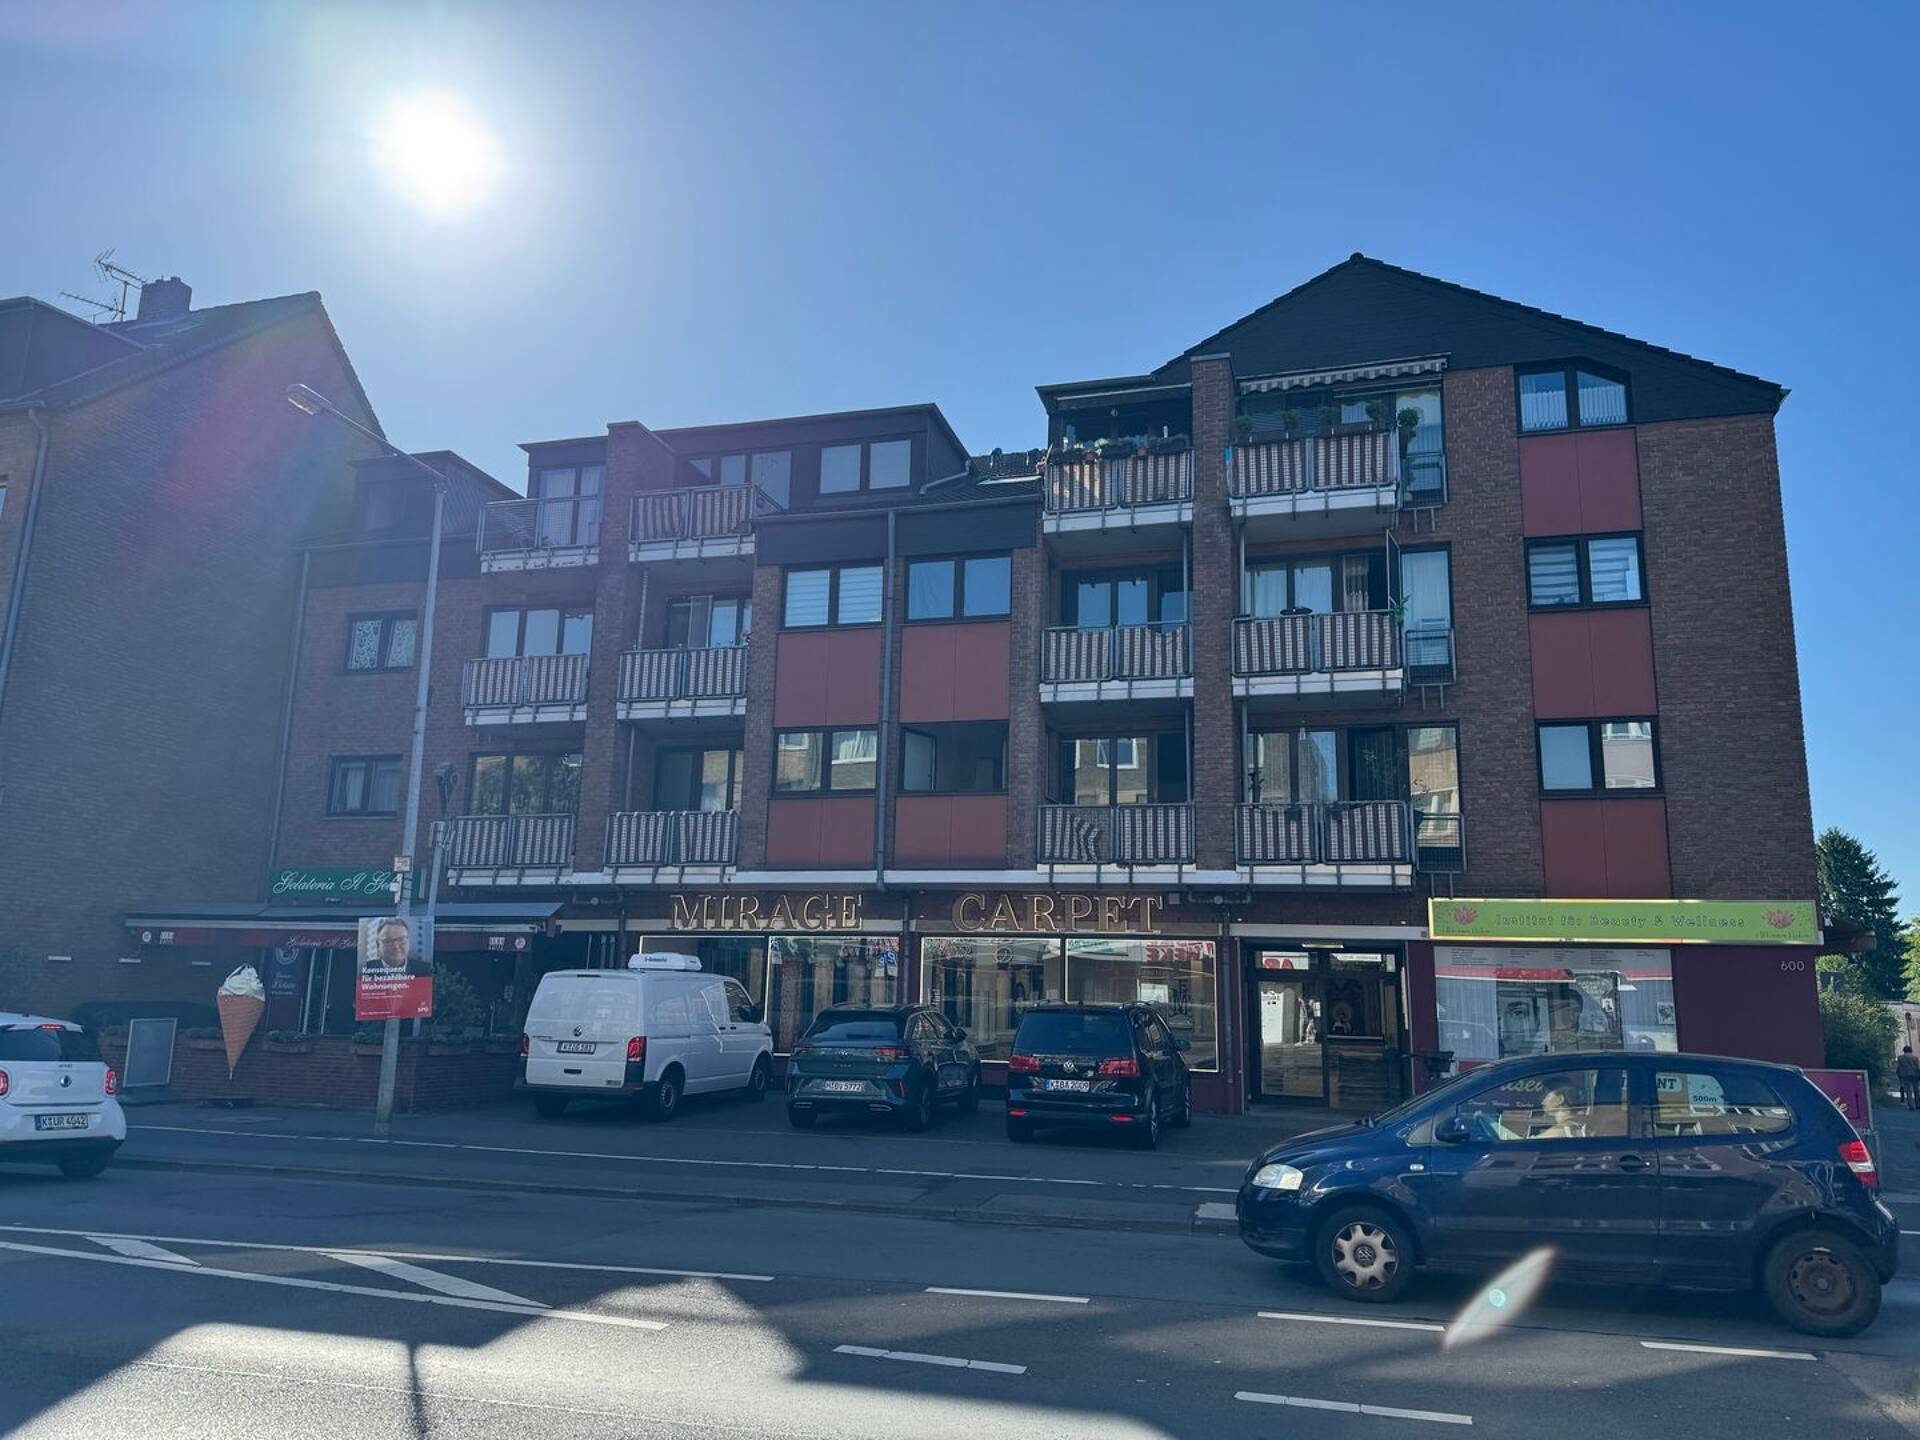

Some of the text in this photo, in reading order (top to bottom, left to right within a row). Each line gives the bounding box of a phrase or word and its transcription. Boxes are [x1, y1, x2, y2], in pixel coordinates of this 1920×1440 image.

[273, 871, 336, 894] Gelateria
[668, 892, 1164, 934] MIRAGE CARPET
[1671, 914, 1745, 928] Wellness
[1780, 960, 1805, 972] 600
[1693, 1095, 1717, 1103] 500m
